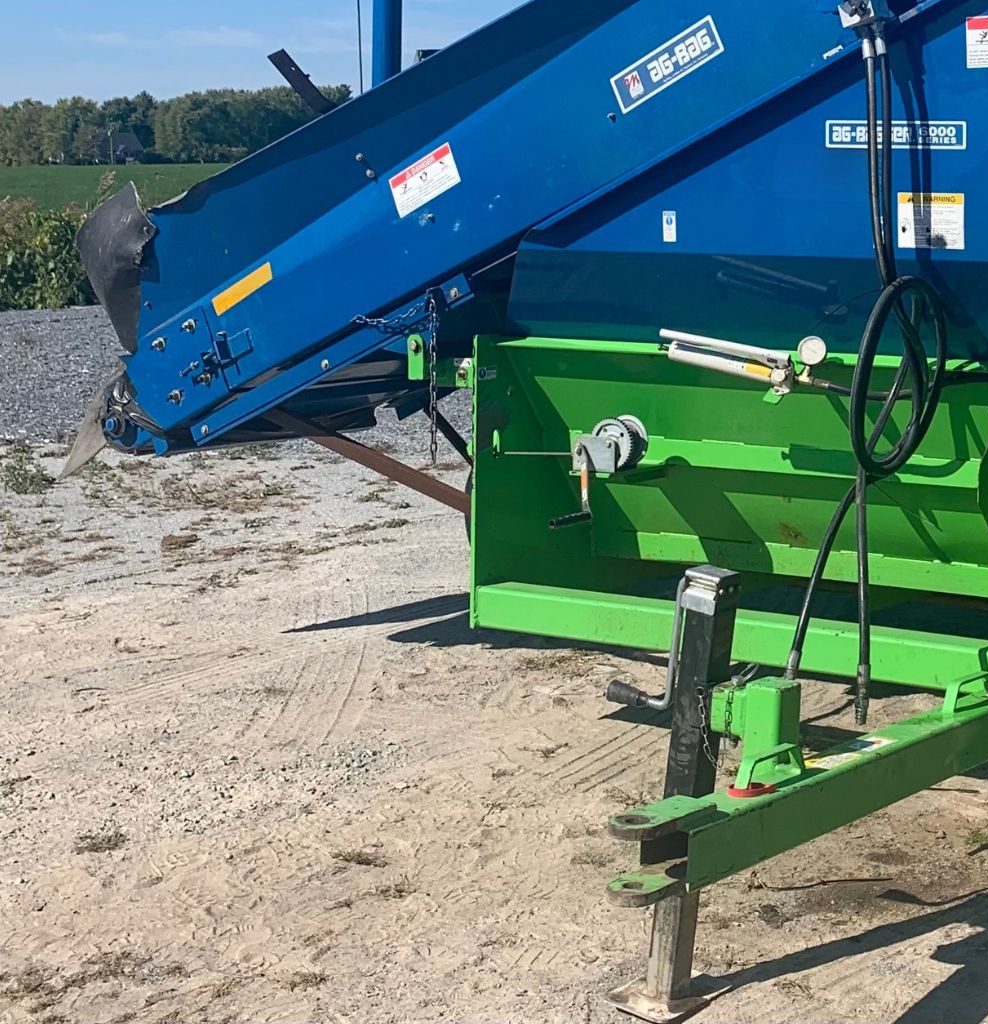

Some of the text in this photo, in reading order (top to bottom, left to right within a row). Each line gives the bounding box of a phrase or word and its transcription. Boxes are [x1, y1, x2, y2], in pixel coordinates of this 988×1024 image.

[919, 126, 957, 137] 6000
[918, 136, 957, 144] SERIES
[411, 155, 436, 175] DANGER
[922, 195, 956, 203] WARNING
